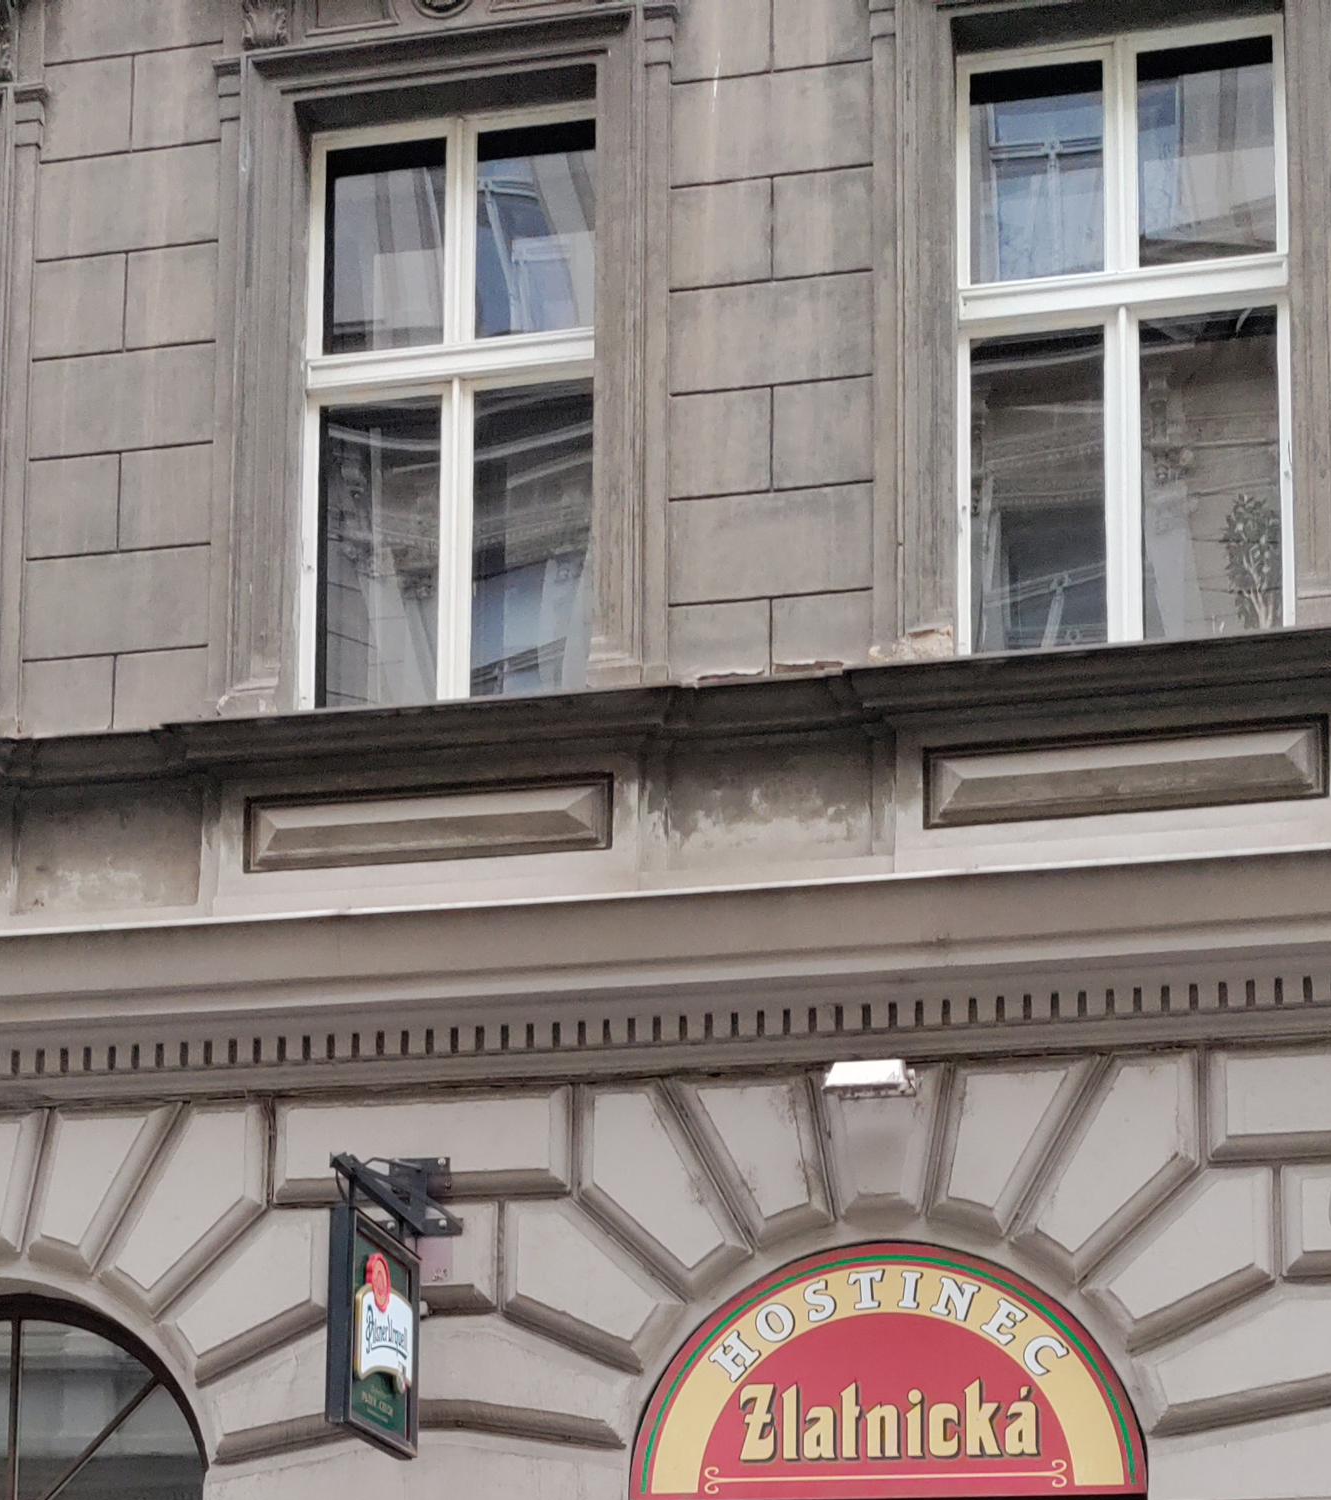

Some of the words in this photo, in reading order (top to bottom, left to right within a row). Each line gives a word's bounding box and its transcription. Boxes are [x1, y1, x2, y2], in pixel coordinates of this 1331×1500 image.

[365, 1304, 389, 1354] Pilsner
[387, 1315, 408, 1355] Urquell
[707, 1269, 1070, 1383] HOSTINEC
[738, 1377, 1043, 1464] Zlatnická
